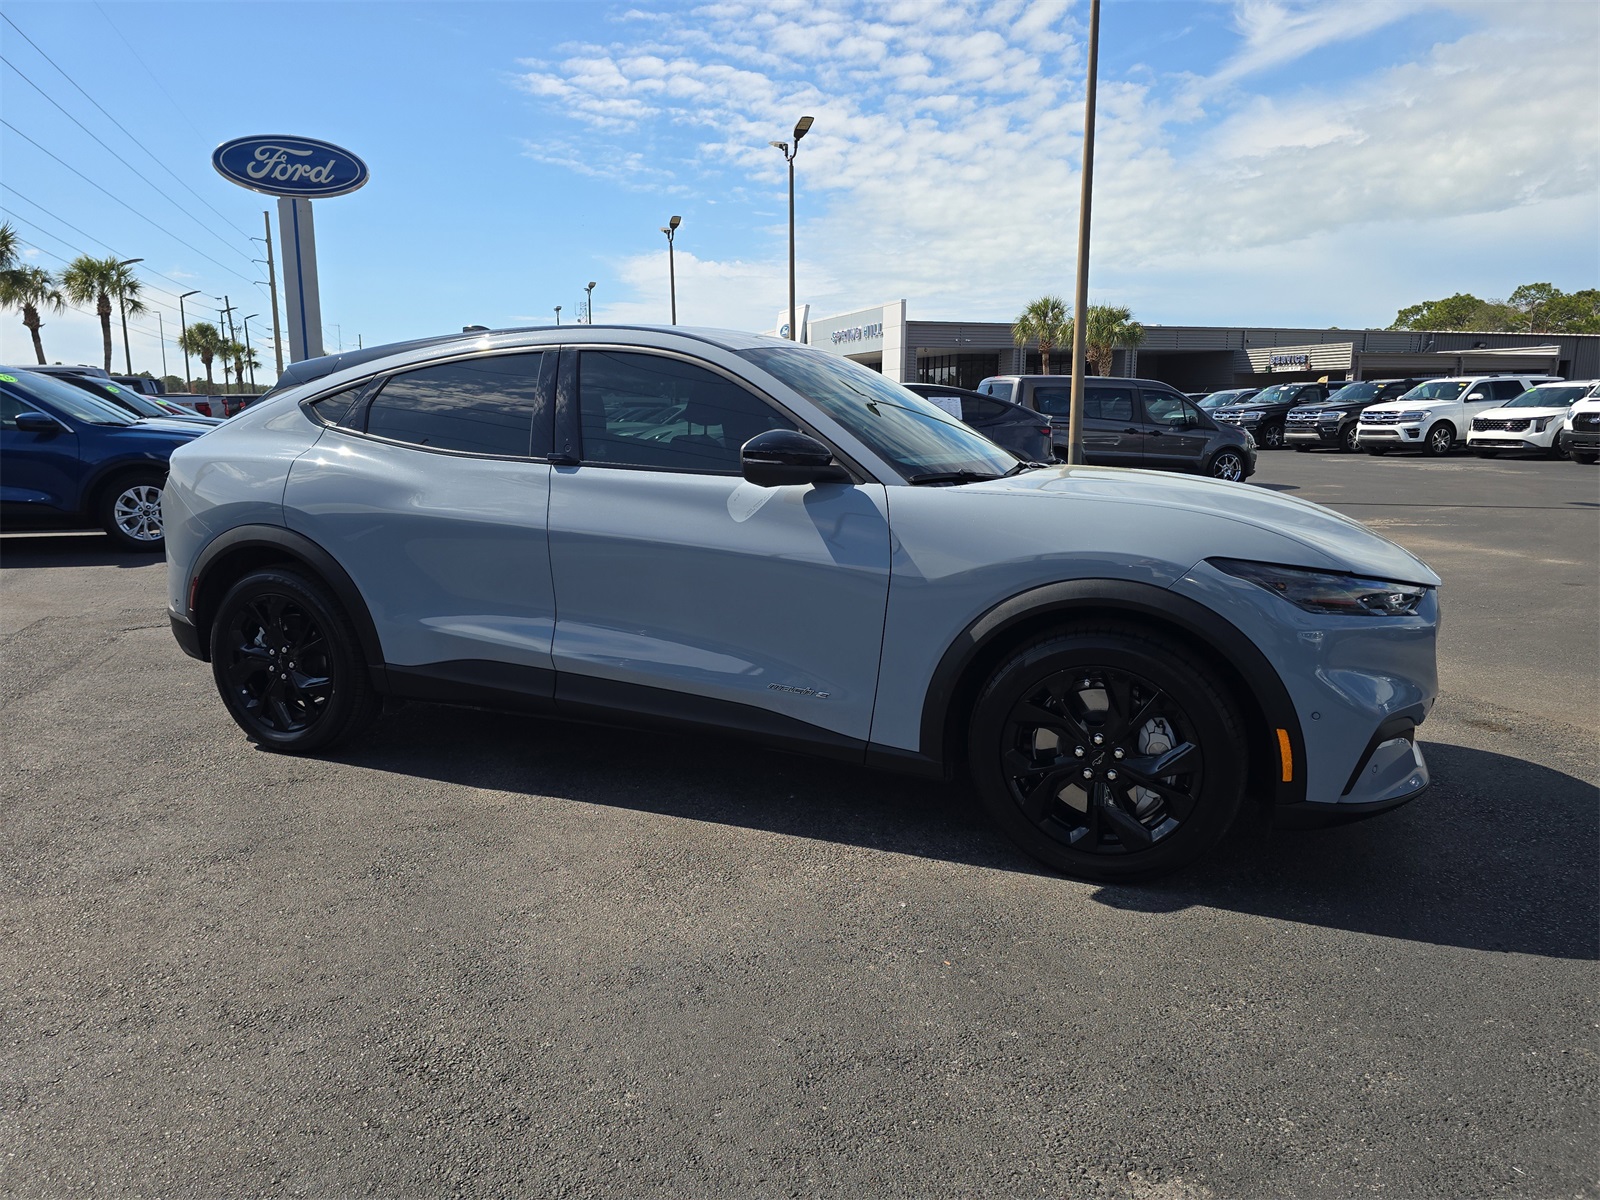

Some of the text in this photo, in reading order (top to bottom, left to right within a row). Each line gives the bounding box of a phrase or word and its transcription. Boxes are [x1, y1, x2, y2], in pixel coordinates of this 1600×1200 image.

[246, 145, 336, 184] Ford
[831, 322, 883, 344] SPRING HILL
[1270, 355, 1306, 365] SERVICE
